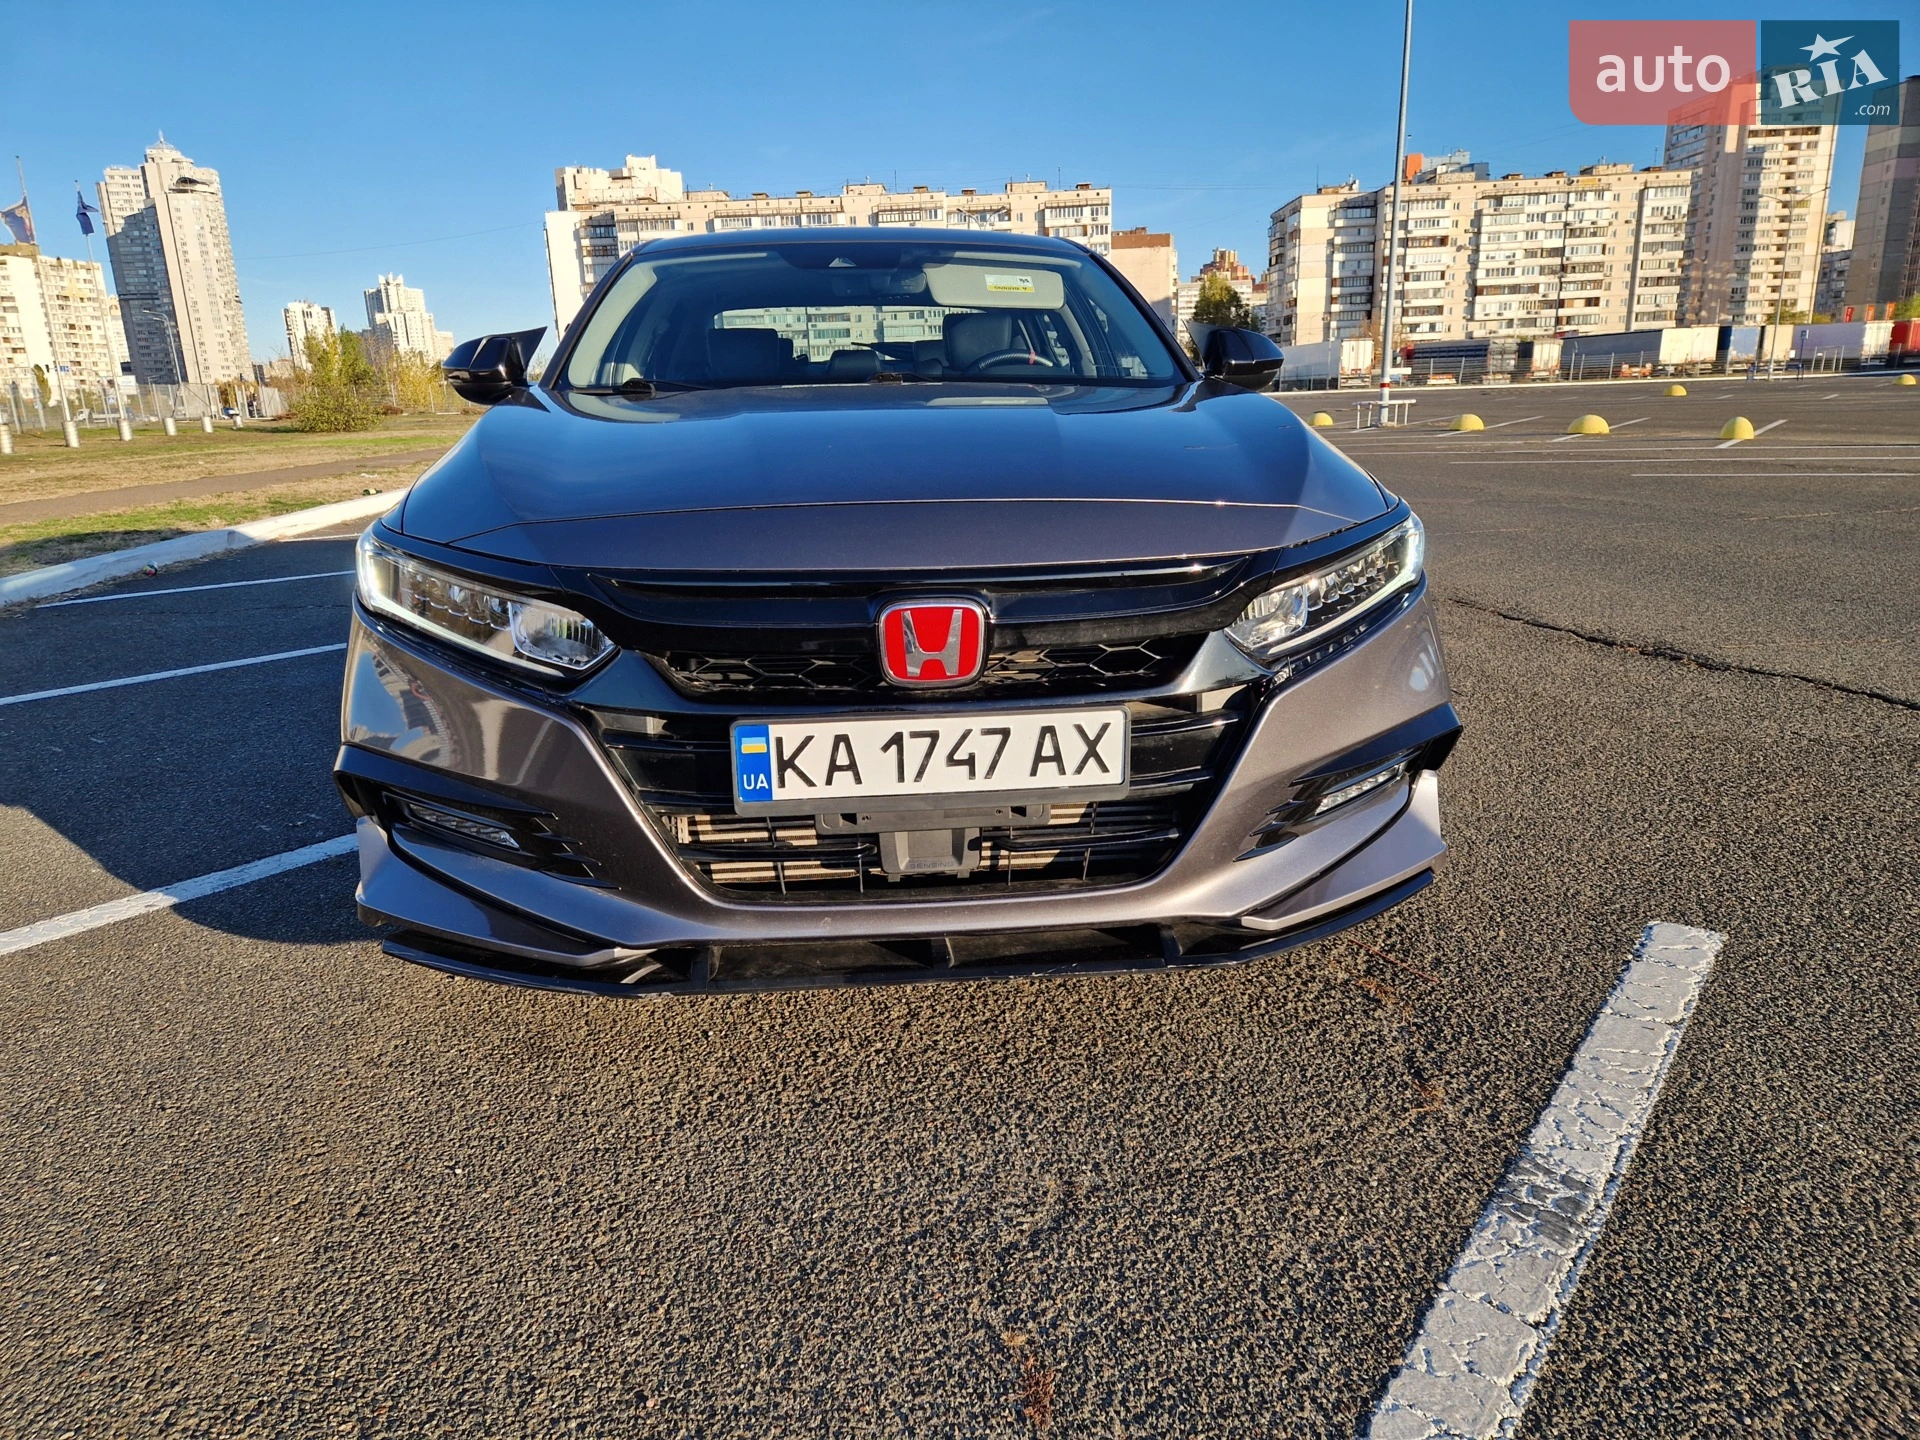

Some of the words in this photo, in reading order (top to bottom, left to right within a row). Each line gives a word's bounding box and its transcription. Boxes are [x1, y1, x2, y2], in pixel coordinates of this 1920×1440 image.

[775, 734, 863, 789] KA
[880, 727, 1011, 783] 1747
[1029, 722, 1111, 777] AX
[743, 773, 769, 790] UA
